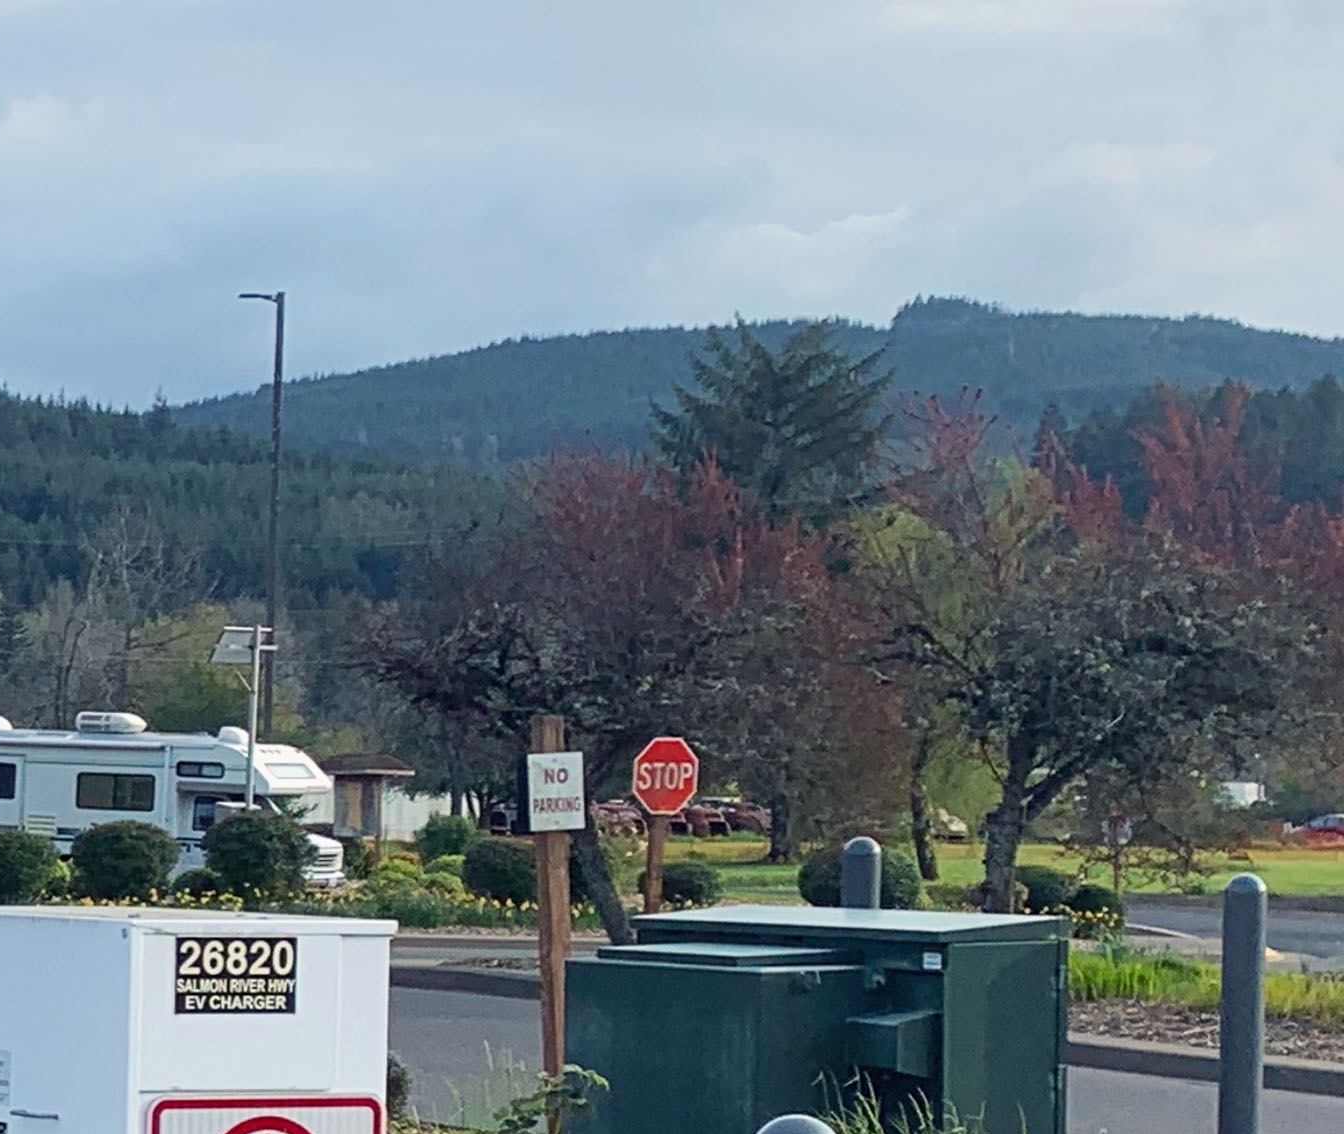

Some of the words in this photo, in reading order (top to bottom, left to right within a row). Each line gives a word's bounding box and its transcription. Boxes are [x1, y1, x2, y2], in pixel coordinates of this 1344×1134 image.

[543, 768, 569, 784] NO
[638, 762, 693, 790] STOP
[533, 797, 582, 814] PARKING
[179, 940, 295, 976] 26820
[176, 978, 228, 993] SALMON
[229, 978, 266, 993] RIVER
[268, 979, 295, 994] HWY
[185, 995, 207, 1010] EV
[209, 994, 287, 1011] CHARGER
